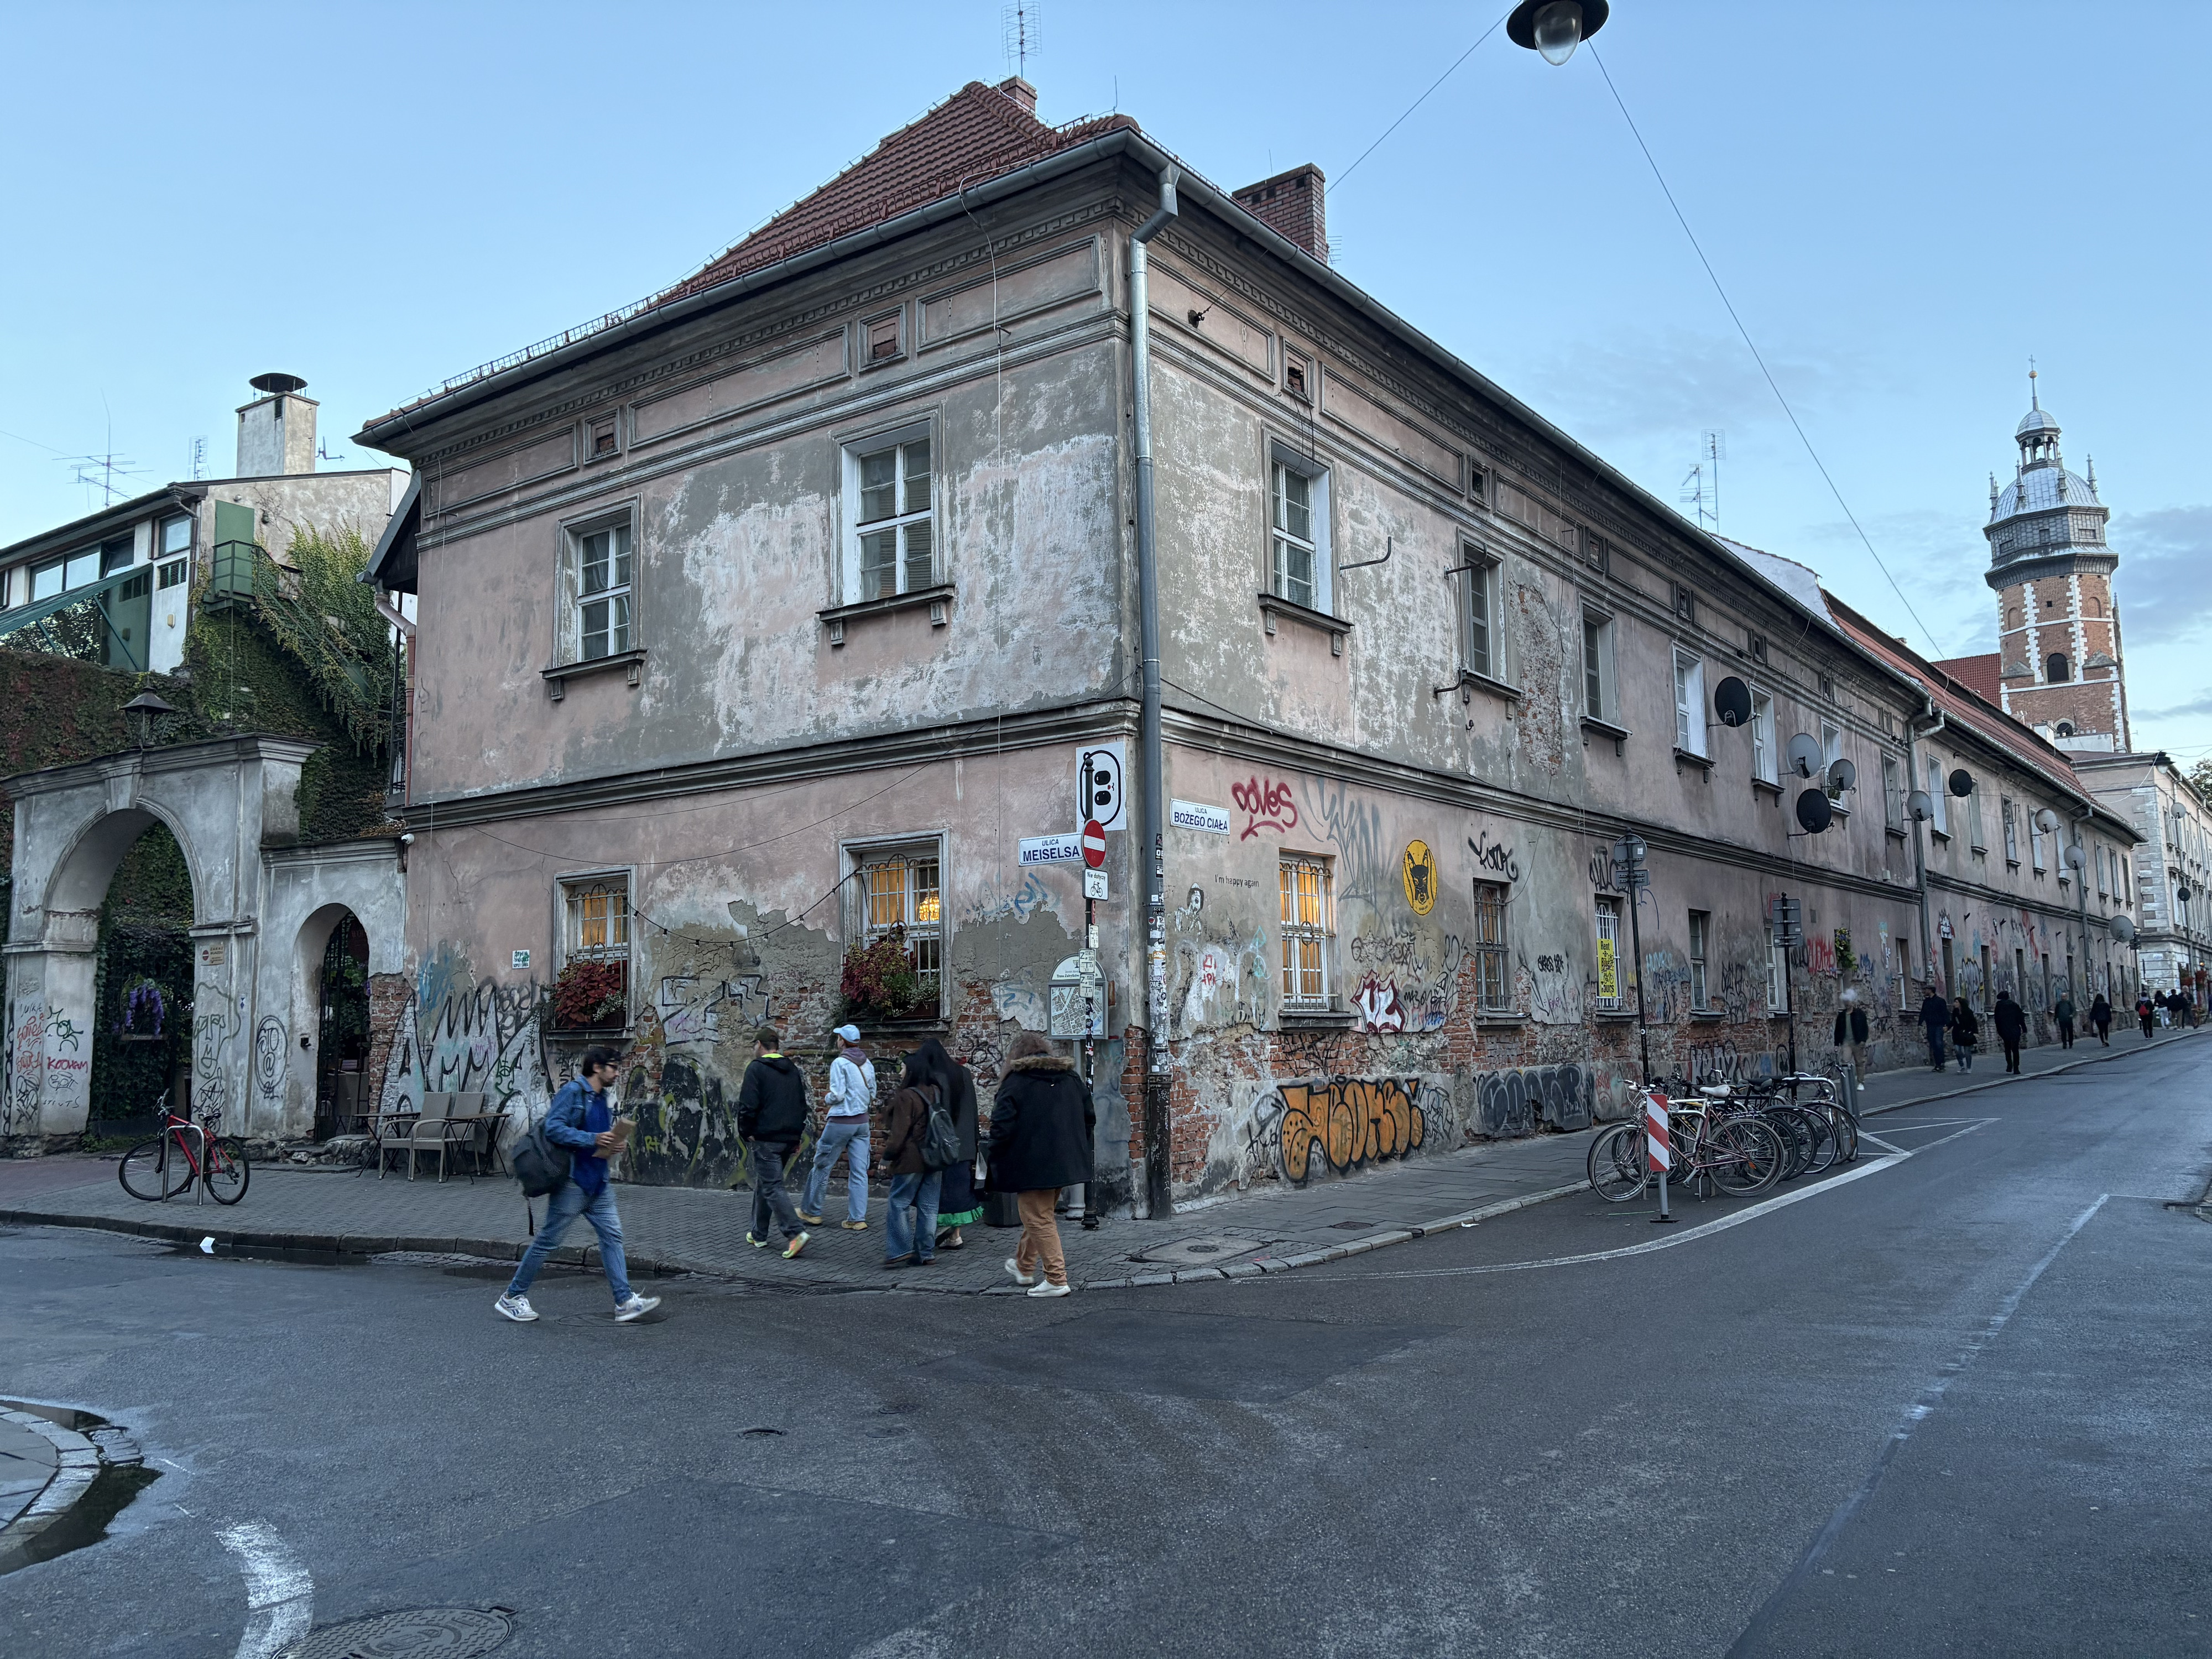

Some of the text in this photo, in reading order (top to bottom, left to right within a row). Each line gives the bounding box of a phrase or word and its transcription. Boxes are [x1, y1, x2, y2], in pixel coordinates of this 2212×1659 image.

[1174, 811, 1228, 831] BOŻEGO CIAŁA
[1023, 845, 1080, 862] MEISELSA
[1094, 873, 1106, 881] dotyczy
[1214, 874, 1260, 888] I'm happy again
[1601, 941, 1610, 951] Rent
